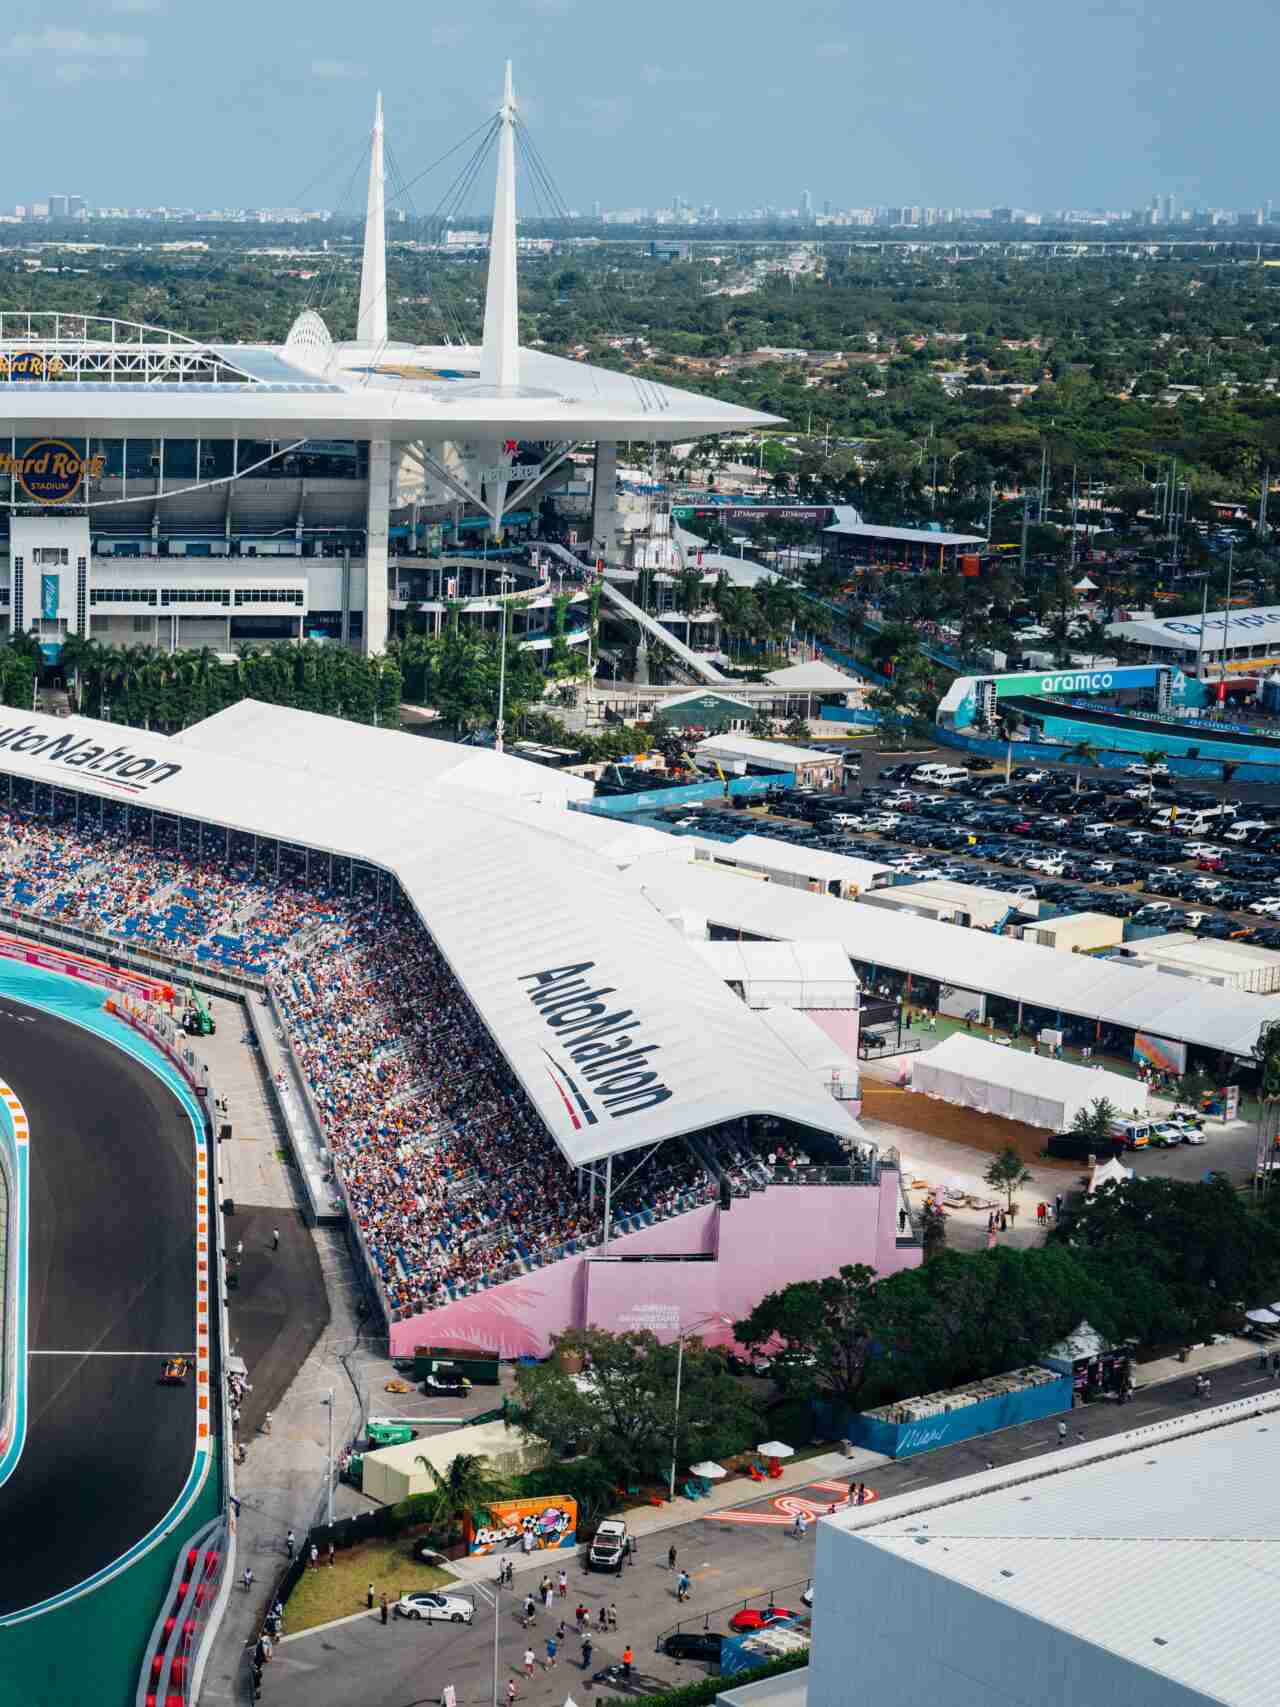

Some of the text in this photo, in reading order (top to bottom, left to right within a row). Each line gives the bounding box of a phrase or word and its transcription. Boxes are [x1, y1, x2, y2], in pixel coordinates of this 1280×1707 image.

[52, 452, 104, 480] Rock
[31, 481, 68, 490] STADIUM
[1041, 673, 1113, 692] aramco
[517, 961, 673, 1119] AutoNation
